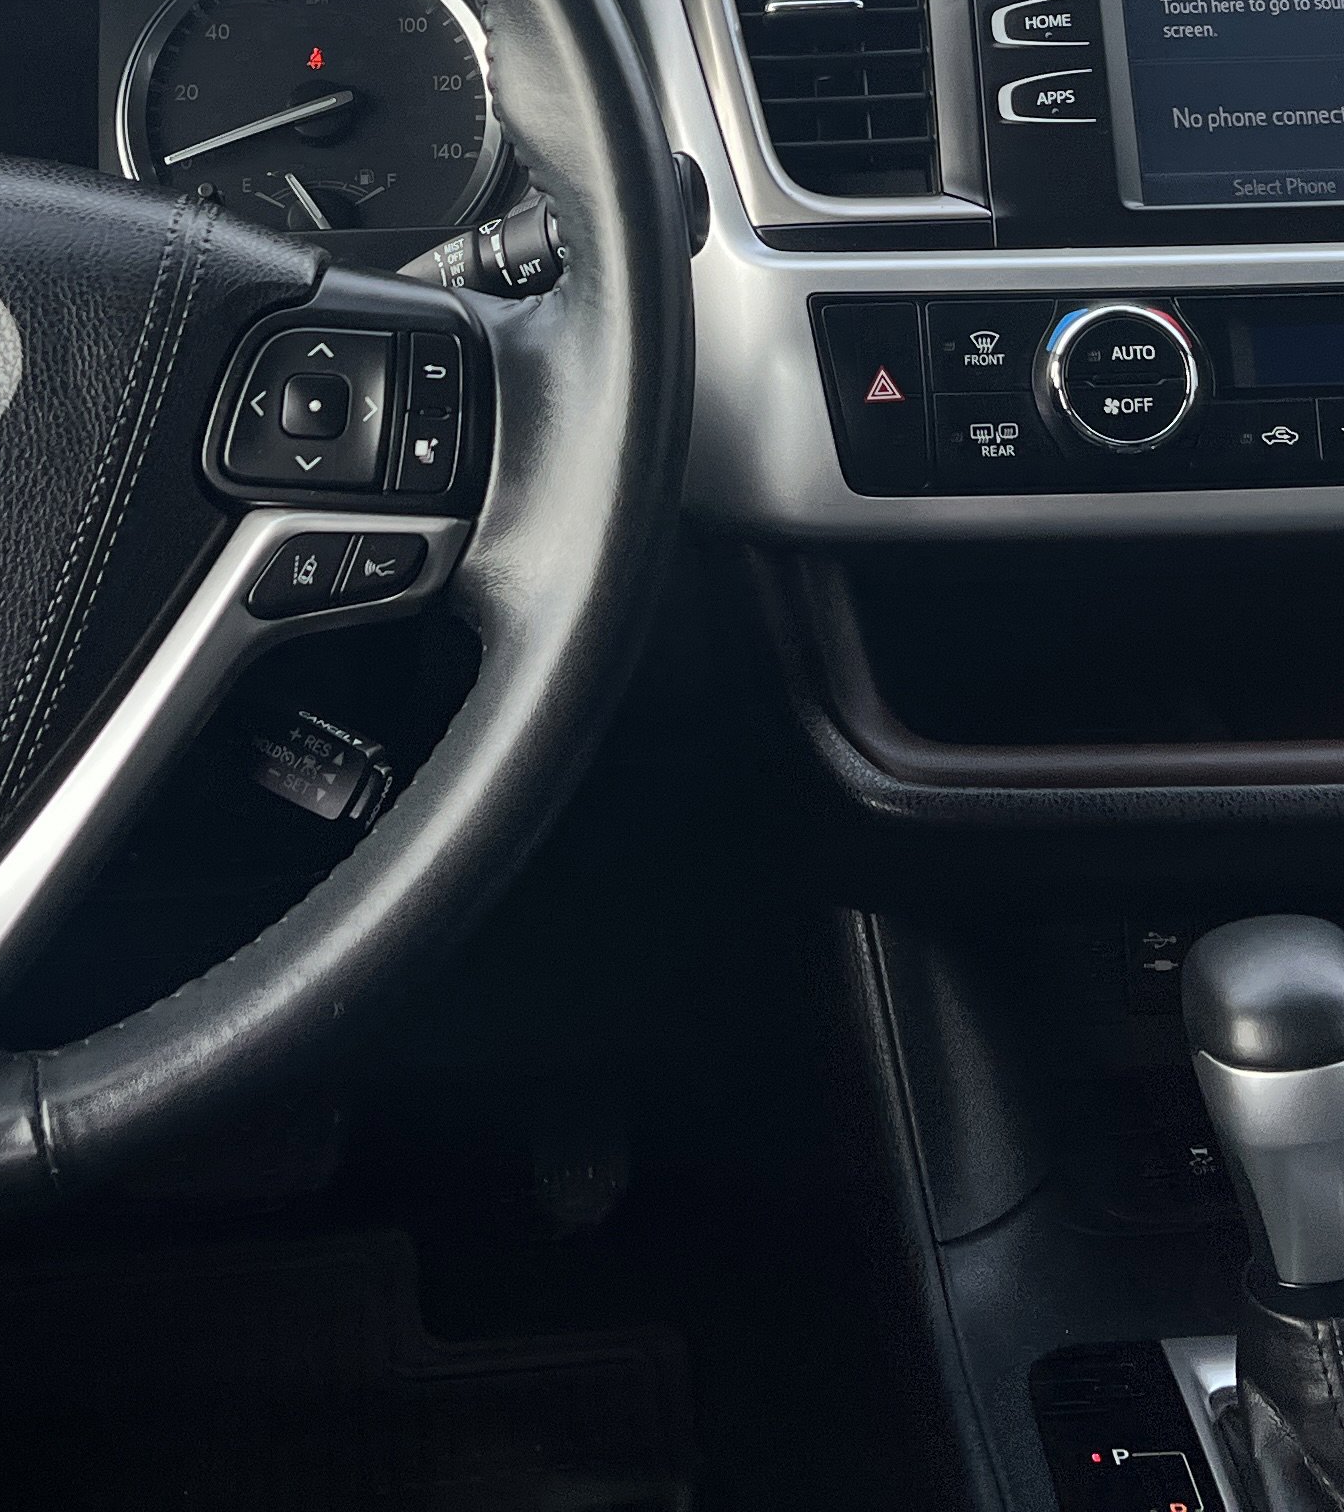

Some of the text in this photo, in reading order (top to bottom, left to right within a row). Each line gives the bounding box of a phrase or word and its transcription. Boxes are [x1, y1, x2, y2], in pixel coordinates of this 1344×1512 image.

[397, 17, 428, 34] 100
[1024, 13, 1072, 30] HOME
[204, 23, 231, 40] 40
[1162, 23, 1219, 39] screen.
[431, 75, 462, 92] 120
[174, 84, 200, 101] 20
[1036, 89, 1076, 106] APPS
[1171, 106, 1204, 129] No
[1207, 106, 1267, 132] phone
[430, 143, 463, 160] 140
[241, 177, 253, 193] E
[386, 172, 397, 188] F
[1232, 175, 1337, 197] Select Phone
[443, 237, 466, 255] MIST
[447, 250, 464, 265] OFF
[450, 261, 466, 276] INT
[963, 354, 1006, 367] FRONT
[1110, 345, 1156, 362] AUTO
[1120, 397, 1154, 414] OFF
[981, 445, 1016, 458] REAR
[298, 710, 352, 743] CANCEL
[303, 734, 333, 758] RES
[1111, 1448, 1130, 1465] P
